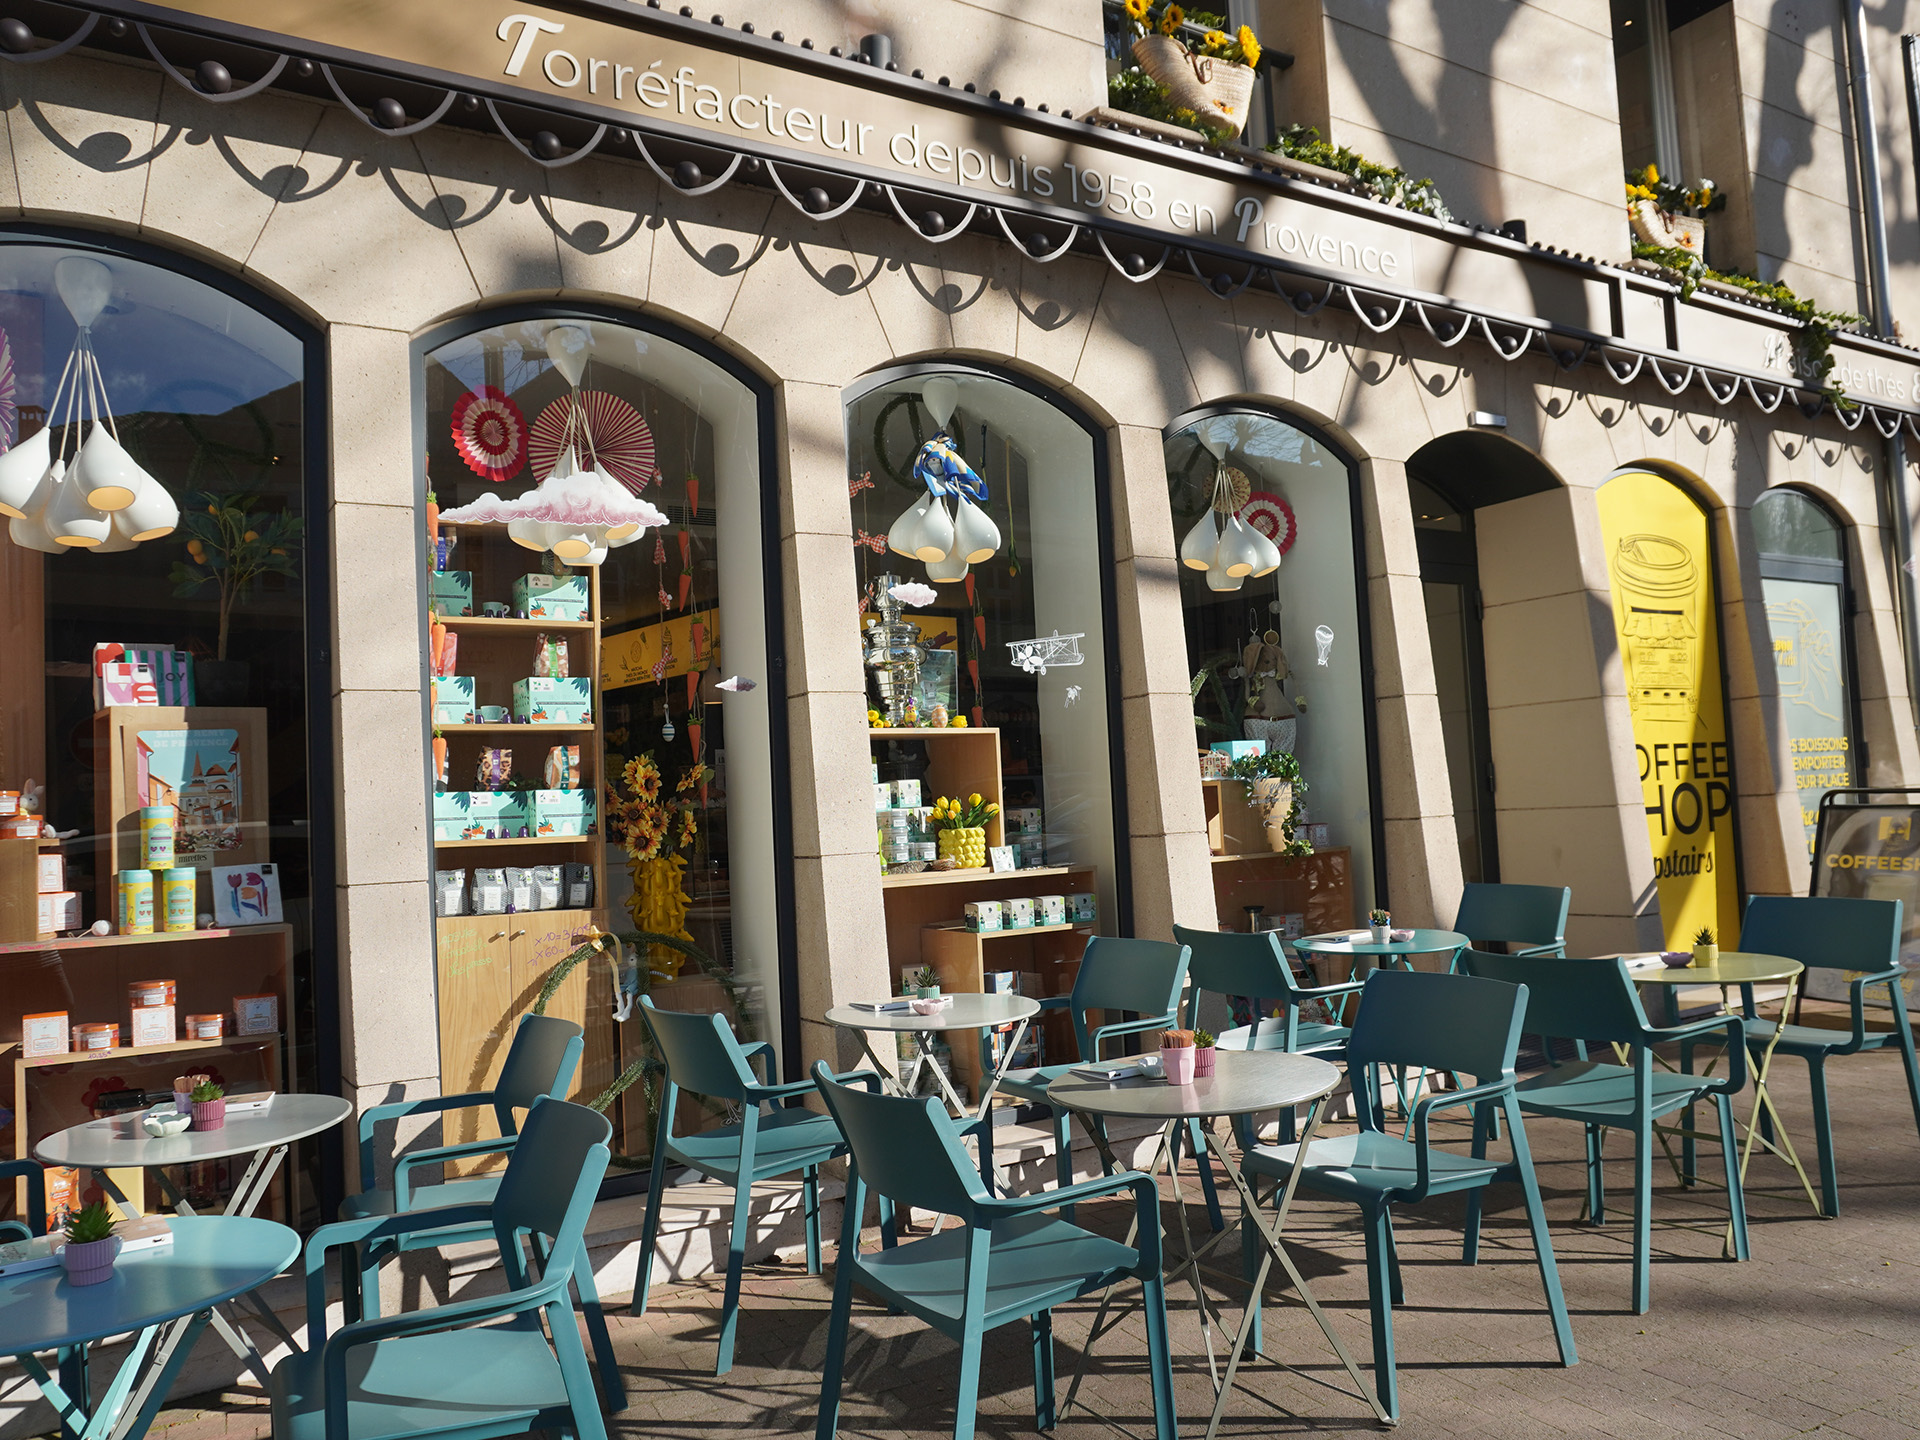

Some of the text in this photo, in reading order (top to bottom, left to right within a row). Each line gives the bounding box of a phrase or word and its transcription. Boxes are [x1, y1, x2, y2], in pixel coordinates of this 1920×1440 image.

[496, 13, 1399, 278] Torréfacteur depuis 1958 en Provence
[1840, 361, 1864, 390] de
[1867, 368, 1905, 400] thés
[158, 672, 185, 683] JOY
[1636, 742, 1730, 782] OFFEE
[1800, 737, 1848, 752] BOISSONS
[1793, 755, 1845, 771] EMPORTER
[1797, 772, 1850, 789] SUR PLACE
[1645, 782, 1731, 836] HOP
[1654, 845, 1714, 880] pstairs
